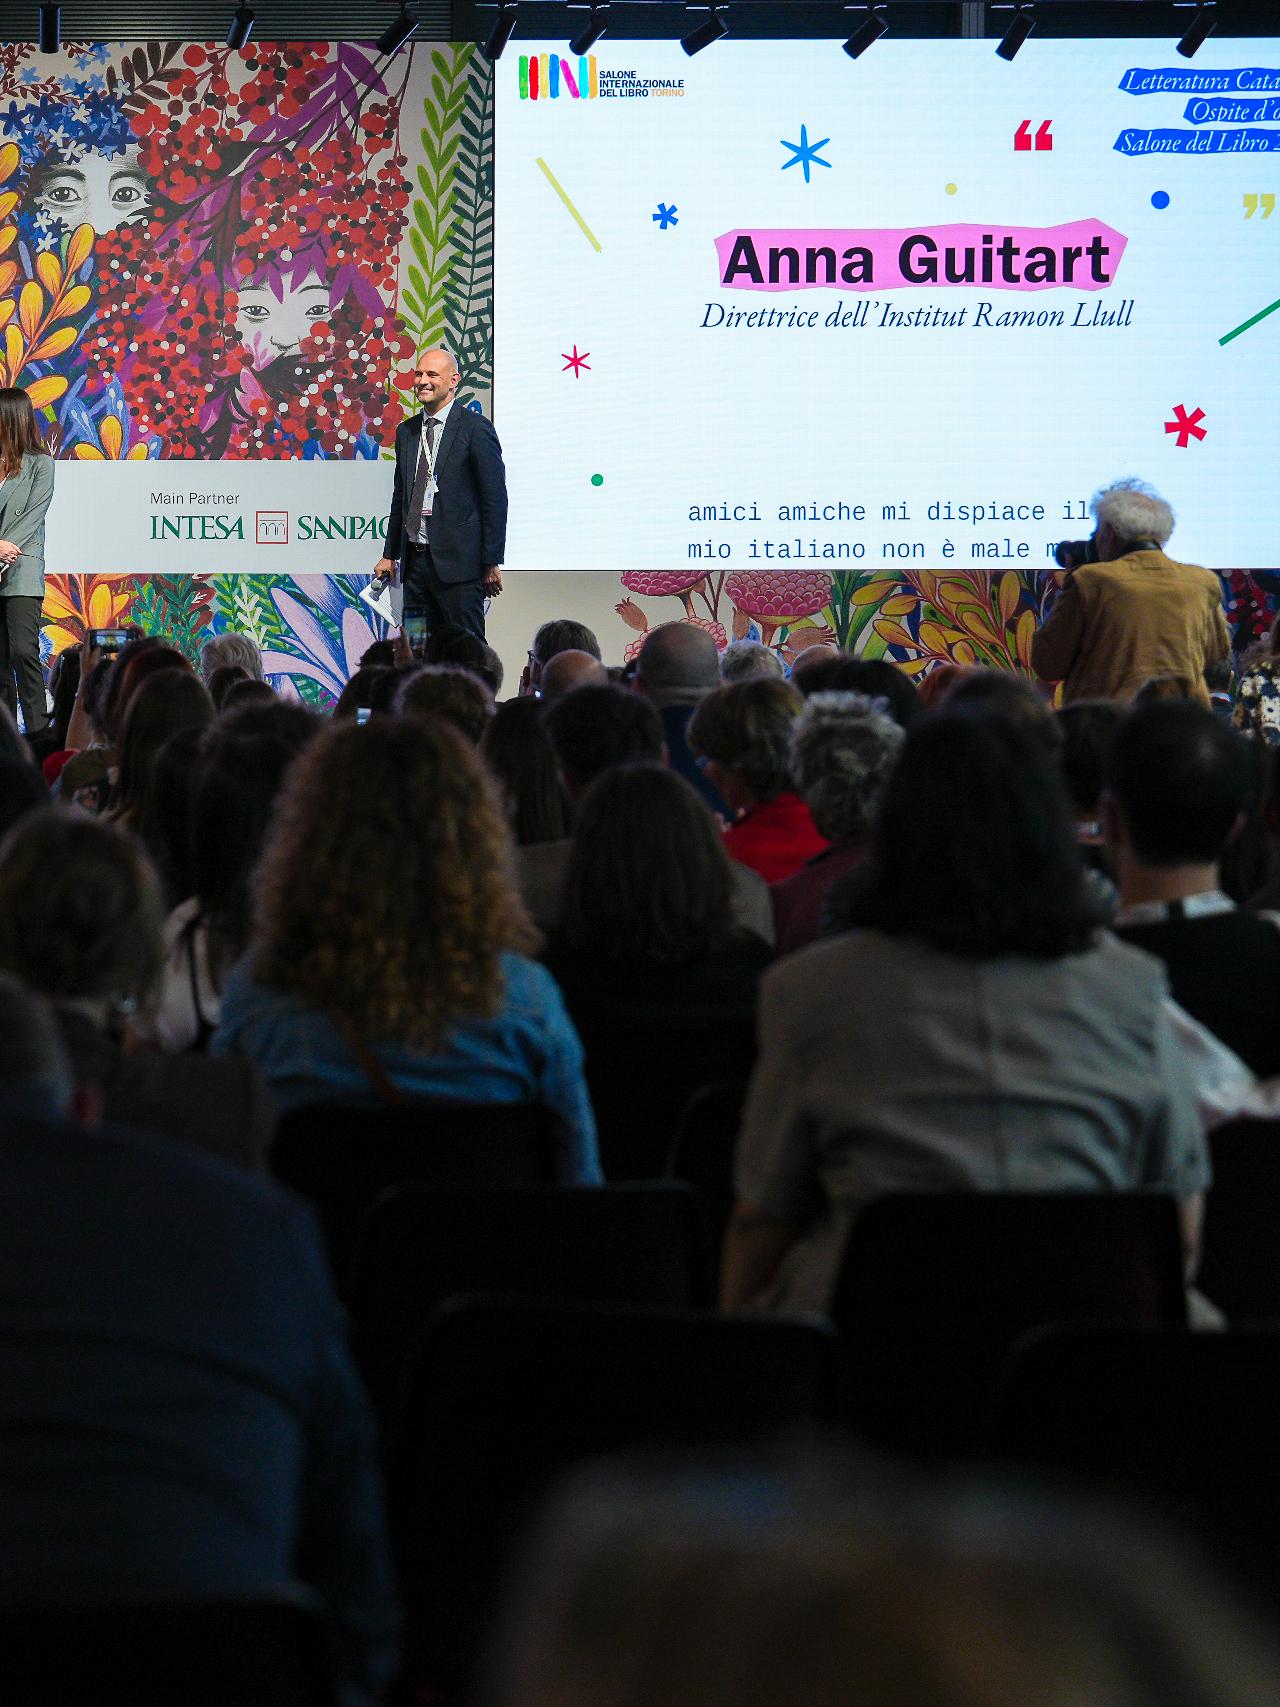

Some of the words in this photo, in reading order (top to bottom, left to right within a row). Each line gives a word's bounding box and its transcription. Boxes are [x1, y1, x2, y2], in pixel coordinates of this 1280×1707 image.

[600, 80, 684, 88] INTERNAZIONALE
[1124, 71, 1230, 90] Letteratura
[1236, 70, 1280, 90] Cata
[600, 89, 617, 97] DEL
[620, 89, 648, 97] LIBRO
[651, 89, 685, 97] TORINO
[1192, 101, 1250, 123] Ospite
[1253, 99, 1280, 121] d'o
[1121, 131, 1182, 152] Salone
[1185, 131, 1214, 152] del
[1217, 131, 1269, 151] Libro
[722, 236, 873, 283] Anna
[899, 235, 1109, 283] Guitart
[700, 303, 818, 327] Direttrice
[973, 303, 1064, 326] Ramon
[1070, 300, 1134, 326] Llull
[151, 493, 183, 504] Main
[190, 493, 239, 504] Partner
[689, 502, 761, 521] amici
[779, 502, 865, 520] amiche
[883, 502, 910, 520] mi
[928, 501, 1044, 525] dispiace
[1062, 501, 1089, 519] il
[150, 515, 245, 539] INTESA
[689, 540, 730, 558] mio
[749, 539, 865, 558] italiano
[883, 543, 924, 557] non
[943, 539, 954, 557] è
[972, 539, 1029, 557] male
